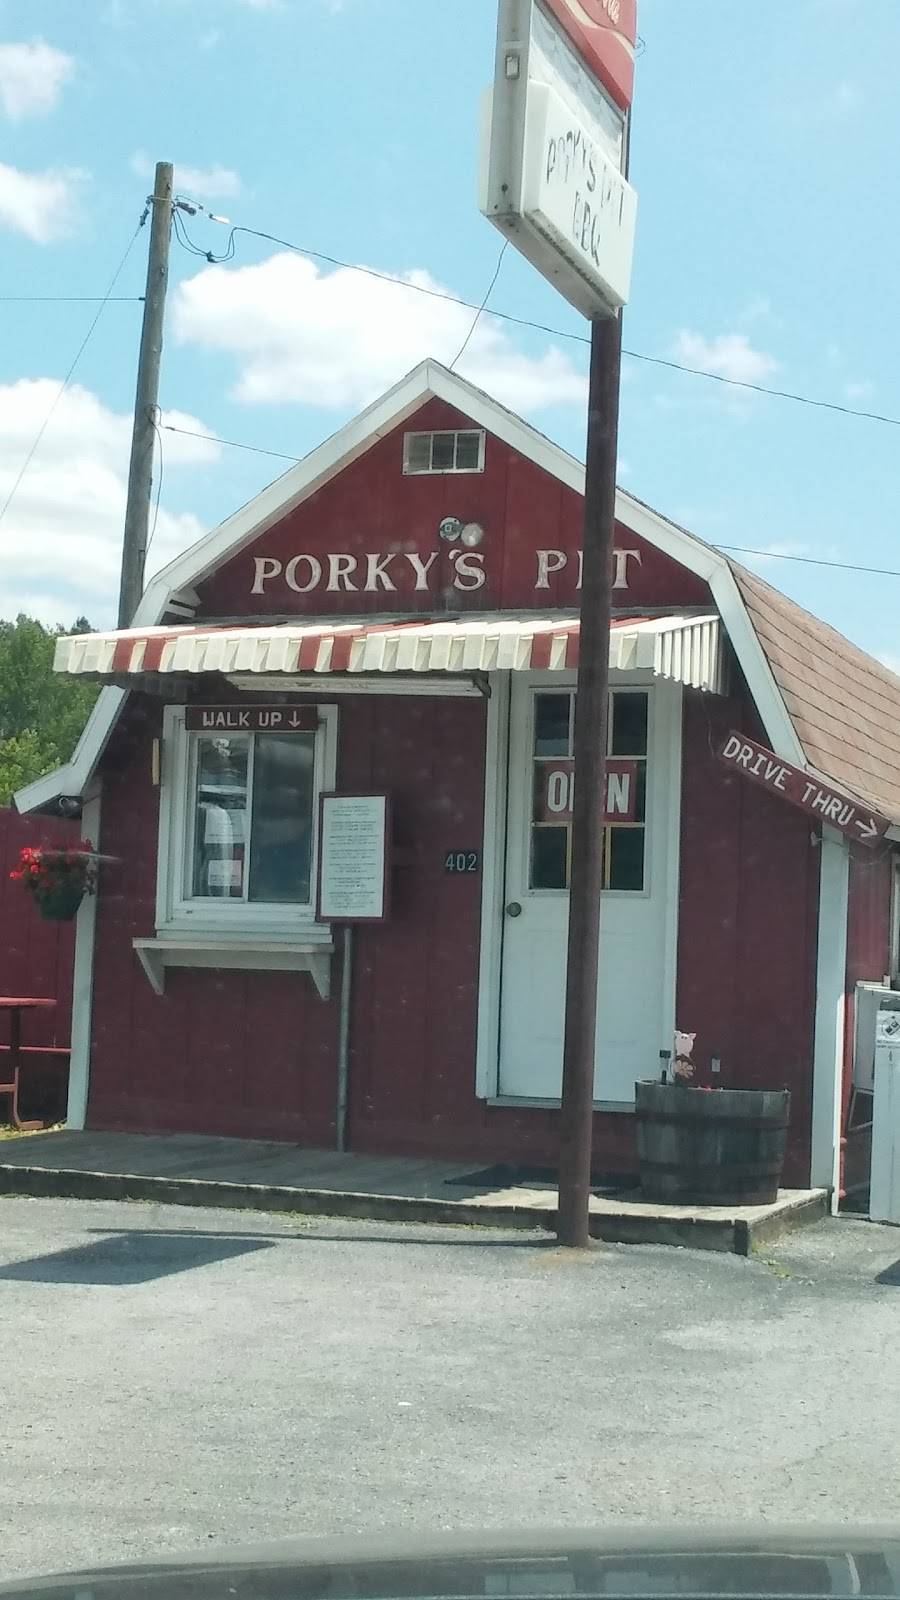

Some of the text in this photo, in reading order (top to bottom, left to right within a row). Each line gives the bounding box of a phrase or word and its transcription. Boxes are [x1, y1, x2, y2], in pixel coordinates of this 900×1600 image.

[250, 550, 487, 594] PORKY'S
[203, 711, 282, 727] WALK UP
[547, 771, 630, 814] ON
[722, 736, 856, 826] DRIVE THRU
[445, 853, 477, 871] 402
